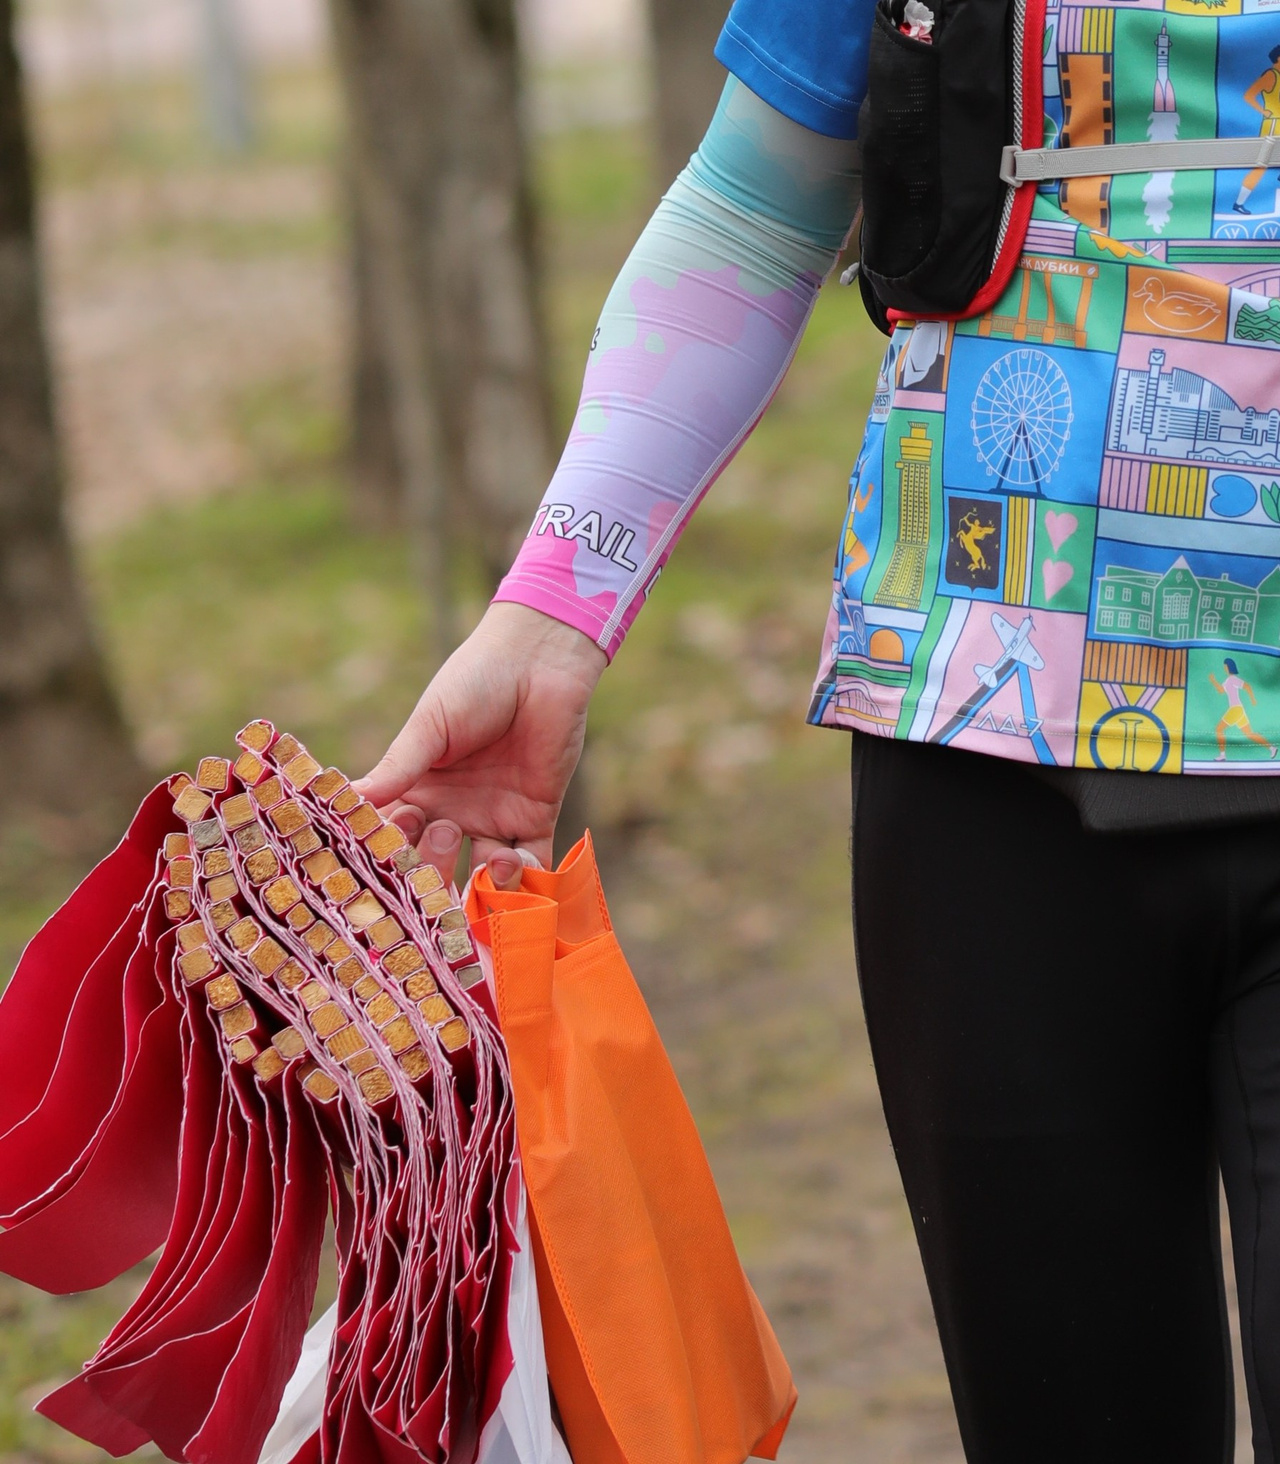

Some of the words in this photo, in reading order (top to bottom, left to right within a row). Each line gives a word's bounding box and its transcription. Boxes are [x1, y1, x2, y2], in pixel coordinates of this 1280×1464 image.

[1034, 260, 1079, 274] ДУБКИ
[526, 503, 638, 573] TRAIL
[977, 711, 1045, 738] ЛА-7
